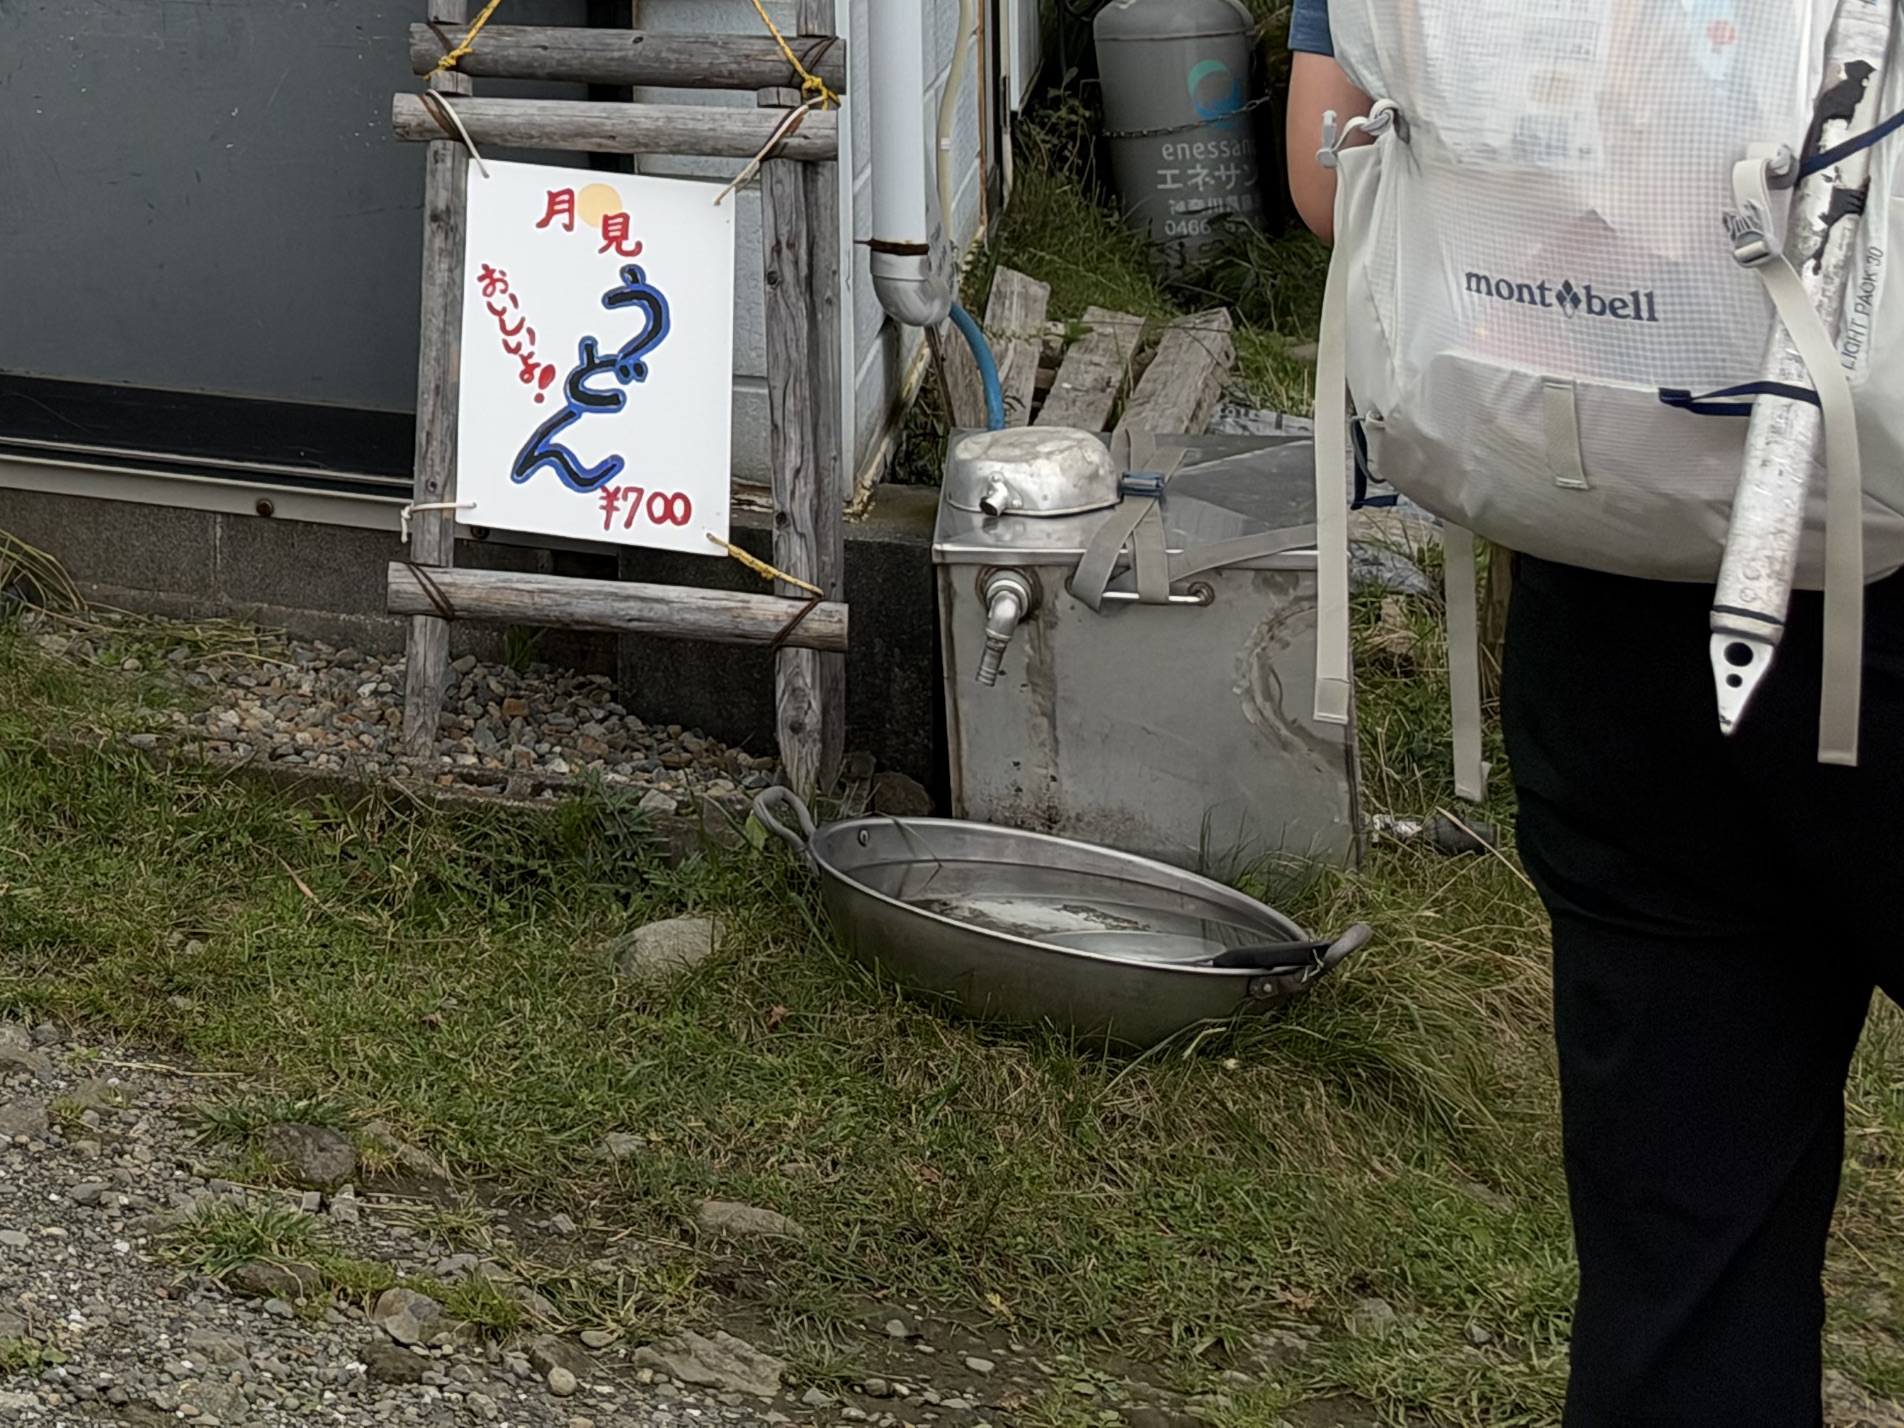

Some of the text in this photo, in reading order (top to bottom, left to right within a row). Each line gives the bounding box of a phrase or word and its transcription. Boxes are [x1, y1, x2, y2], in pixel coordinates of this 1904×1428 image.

[535, 187, 642, 257] 月見
[1841, 317, 1870, 371] LIGHT
[1866, 245, 1884, 267] 30
[510, 264, 671, 493] うどん
[599, 485, 692, 531] ¥700
